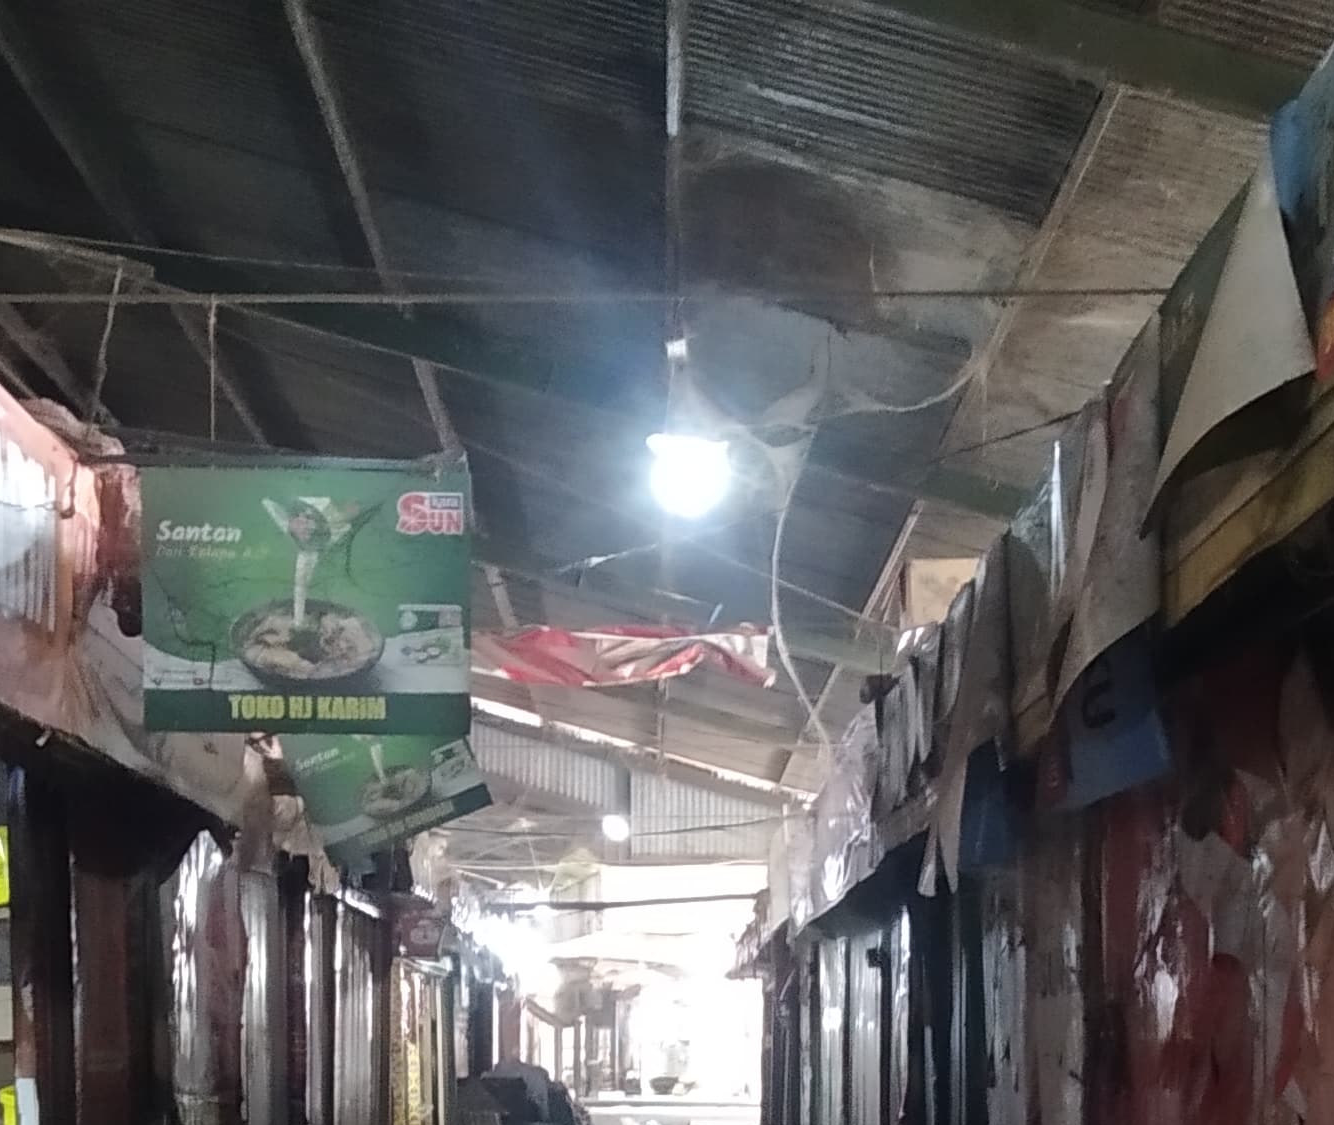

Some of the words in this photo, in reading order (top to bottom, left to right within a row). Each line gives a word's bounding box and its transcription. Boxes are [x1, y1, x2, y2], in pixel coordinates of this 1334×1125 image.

[155, 520, 243, 542] Santan
[229, 695, 286, 720] TOKO
[289, 696, 313, 719] HJ
[317, 696, 387, 720] KARIM
